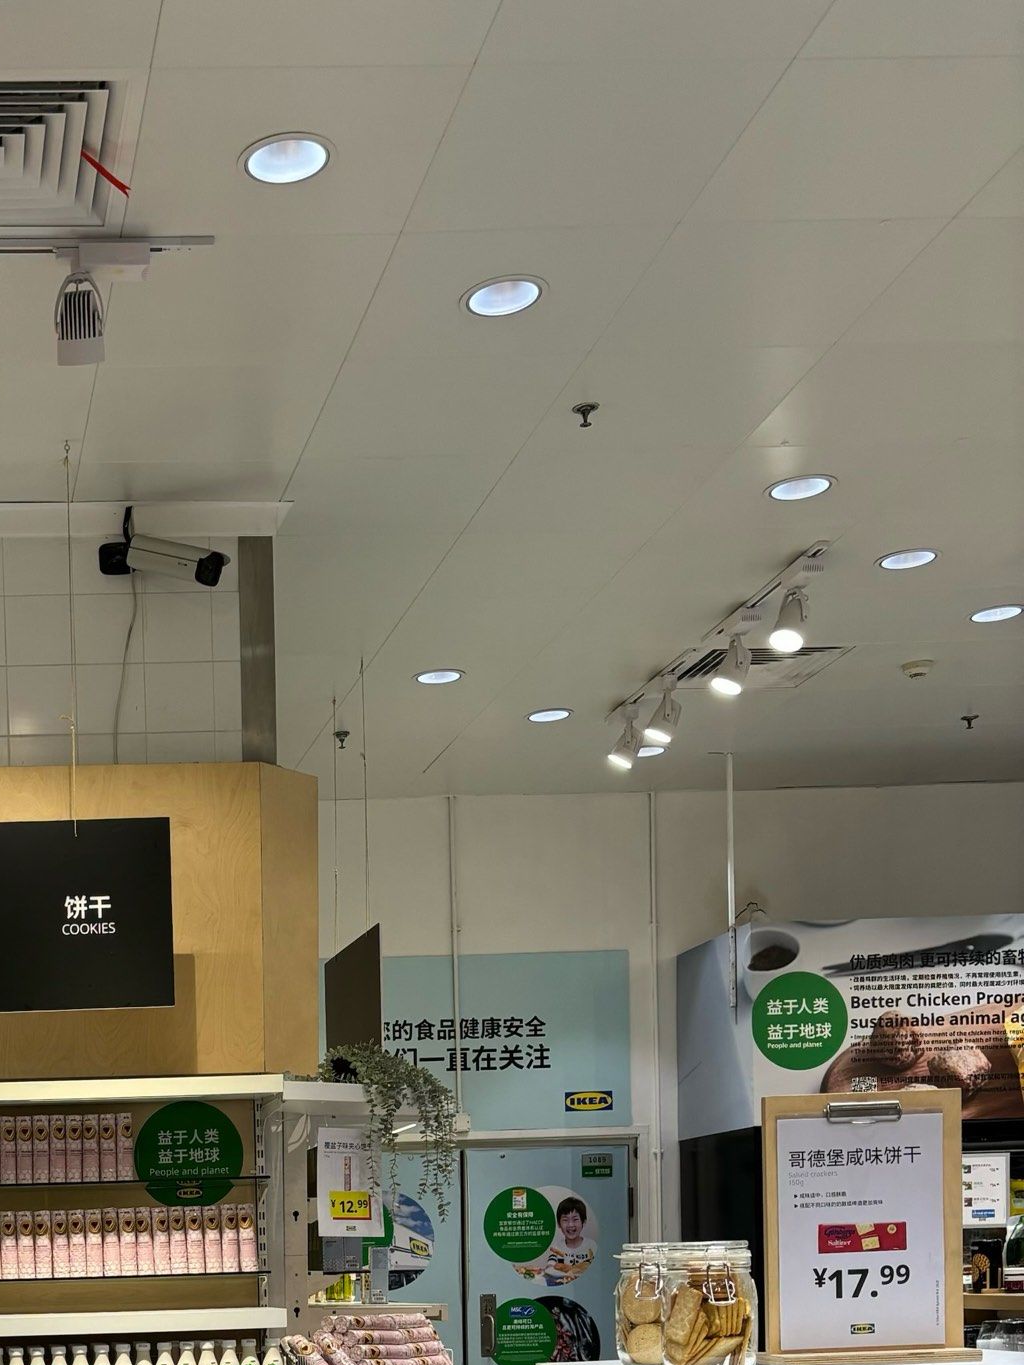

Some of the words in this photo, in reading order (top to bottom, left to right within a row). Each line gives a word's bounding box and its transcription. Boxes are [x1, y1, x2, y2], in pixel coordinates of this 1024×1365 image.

[64, 895, 112, 919] 饼干
[62, 921, 116, 936] COOKIES
[850, 953, 914, 970] 优质鸡肉
[767, 998, 829, 1016] 益于人类
[851, 996, 902, 1009] Better
[906, 993, 971, 1008] Chicken
[851, 1012, 944, 1029] sustainable
[950, 1011, 1006, 1026] animal
[767, 1022, 833, 1041] 益于地球
[803, 1041, 823, 1049] planet
[384, 1045, 551, 1072] 们一直在关注
[569, 1096, 610, 1106] IKEA
[157, 1129, 220, 1145] 益于人类
[157, 1147, 221, 1164] 益于地球
[788, 1145, 922, 1169] 哥德堡咸味饼干
[149, 1167, 179, 1178] People
[182, 1167, 198, 1177] and
[200, 1166, 230, 1177] planet
[788, 1179, 804, 1187] 150g
[813, 1264, 910, 1299] ¥17.99
[852, 1325, 874, 1333] IKEA
